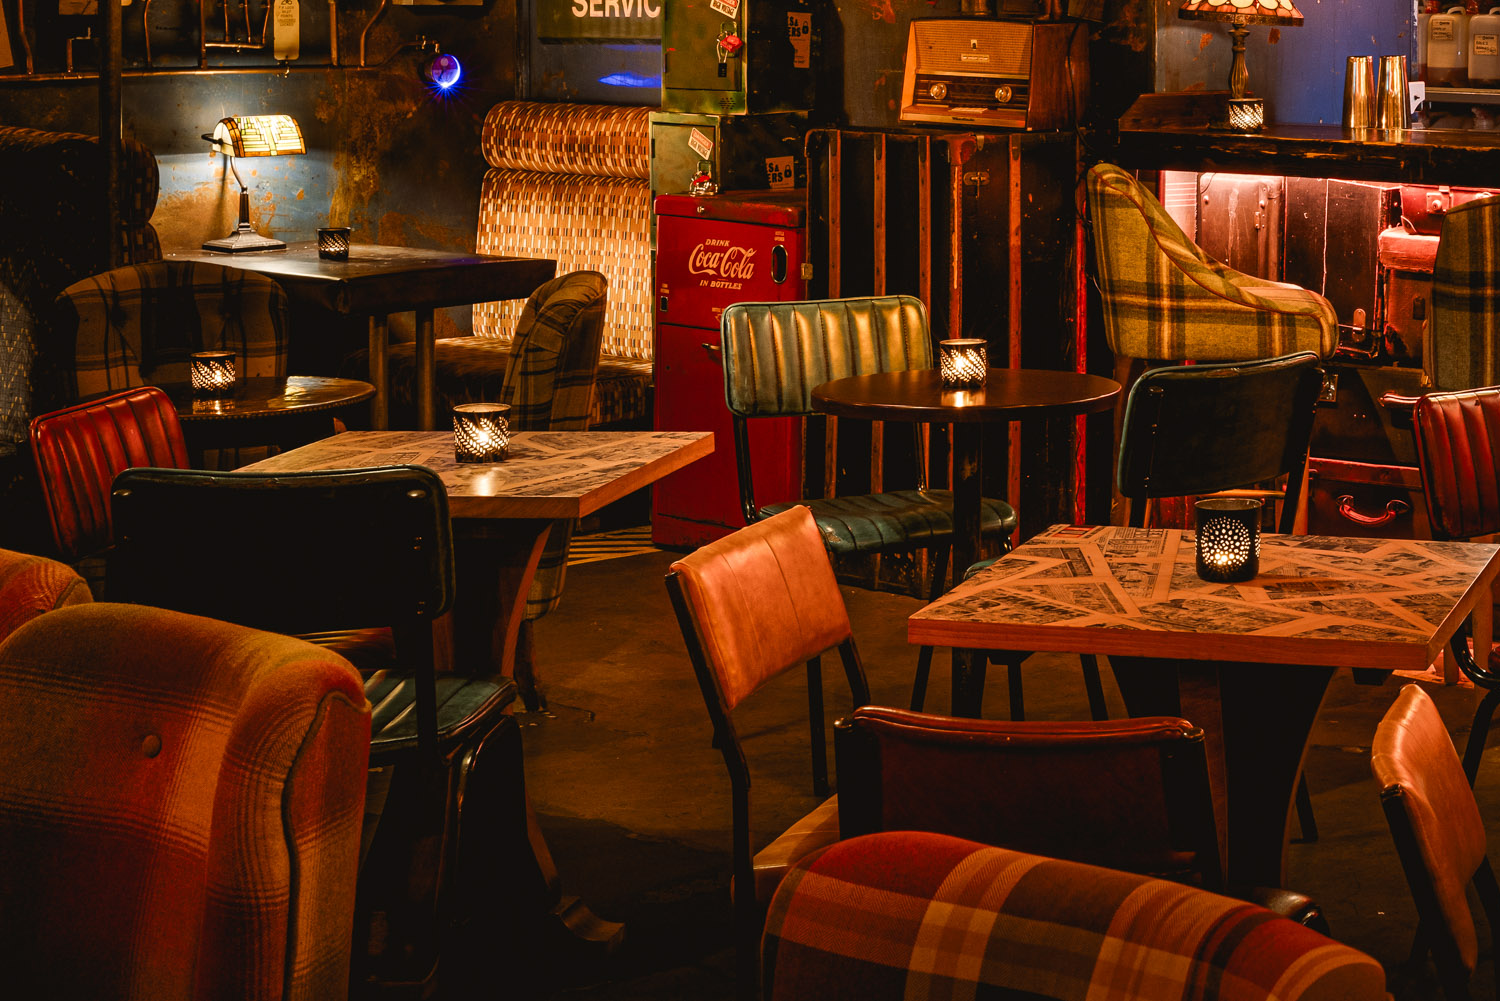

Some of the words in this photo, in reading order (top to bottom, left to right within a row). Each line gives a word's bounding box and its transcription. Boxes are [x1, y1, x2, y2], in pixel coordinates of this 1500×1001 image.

[767, 173, 784, 182] ERS
[704, 238, 730, 248] DRINK
[710, 280, 742, 290] BOTTLES
